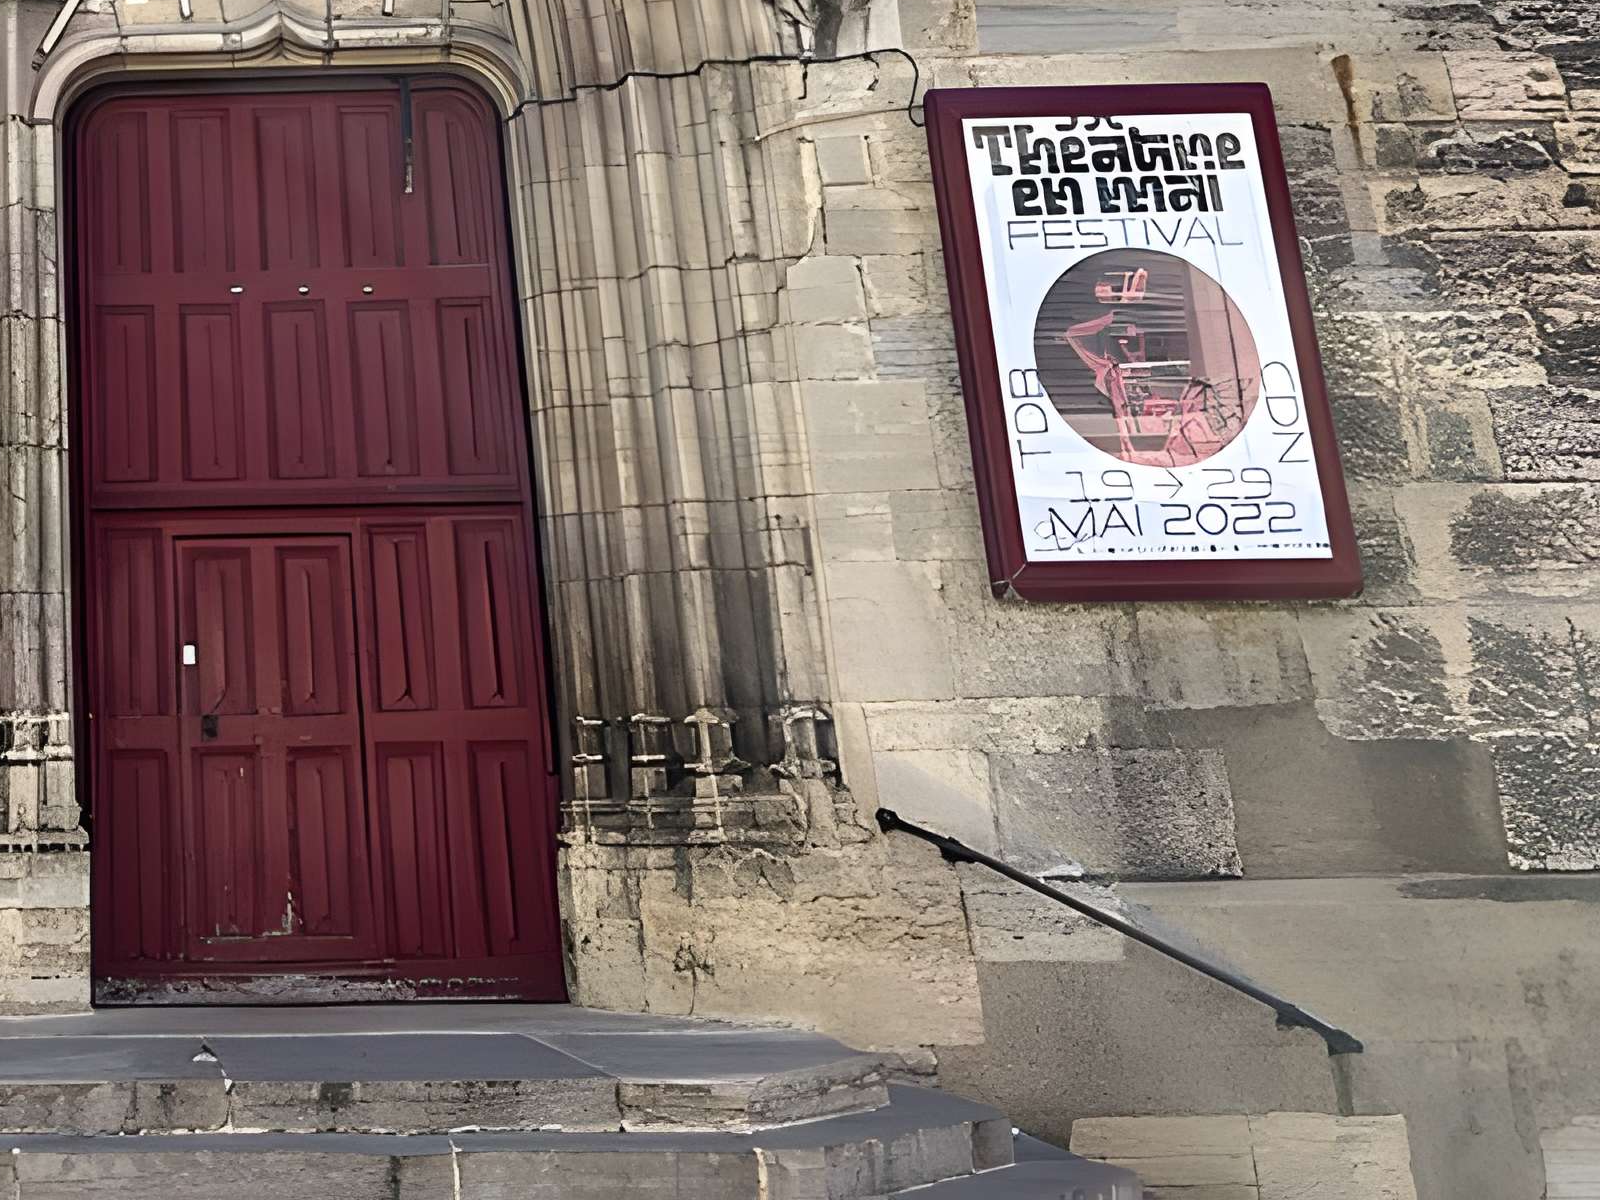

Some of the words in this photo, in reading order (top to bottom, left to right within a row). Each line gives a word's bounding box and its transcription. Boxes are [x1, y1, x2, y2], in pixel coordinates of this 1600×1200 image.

[1011, 176, 1085, 217] en
[1007, 216, 1244, 250] FESTIVAL
[1009, 368, 1052, 469] TDB
[1260, 361, 1310, 463] CDN
[1065, 469, 1134, 502] 19
[1201, 467, 1273, 499] 29
[1048, 503, 1144, 538] MAI
[1159, 501, 1303, 535] 2022
